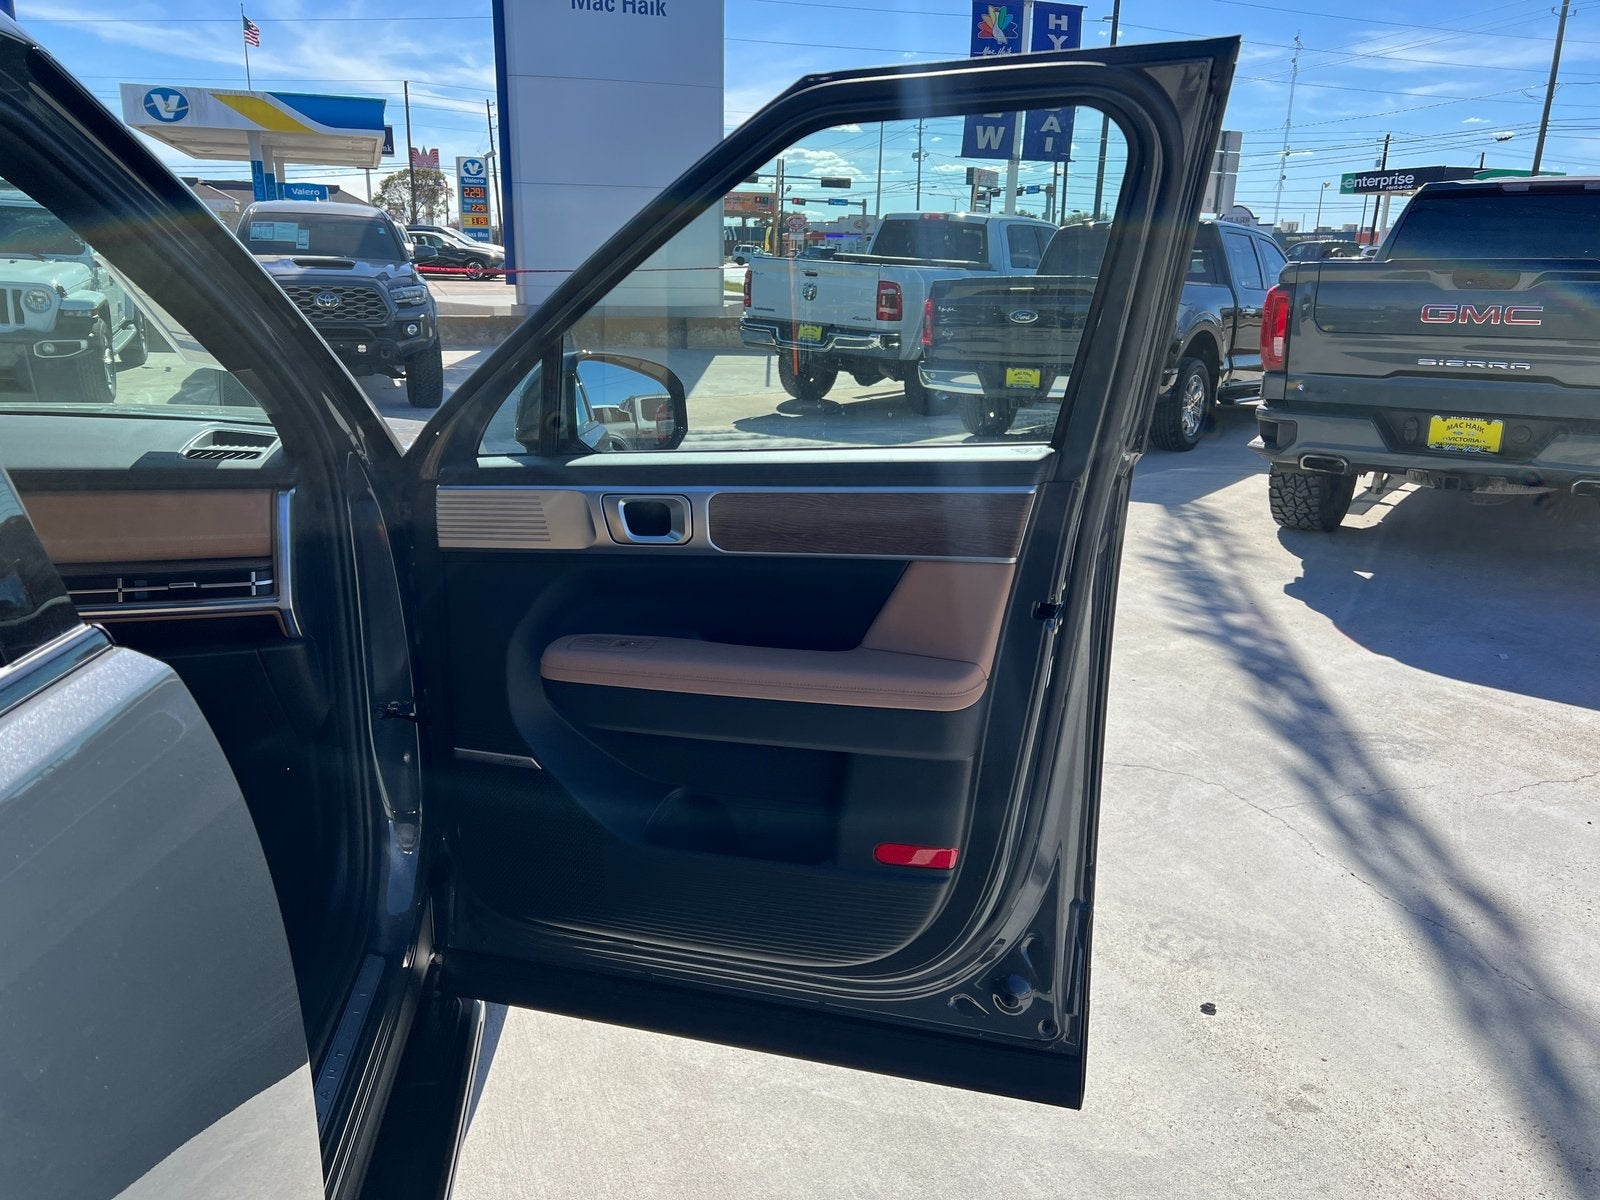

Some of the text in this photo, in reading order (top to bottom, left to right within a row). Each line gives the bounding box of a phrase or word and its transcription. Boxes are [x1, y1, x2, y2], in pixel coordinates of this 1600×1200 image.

[1343, 172, 1415, 191] enterprise
[291, 187, 320, 196] Valero
[1420, 303, 1544, 326] GMC
[1417, 358, 1532, 371] SIERRA
[1446, 422, 1486, 434] MAC HAIK
